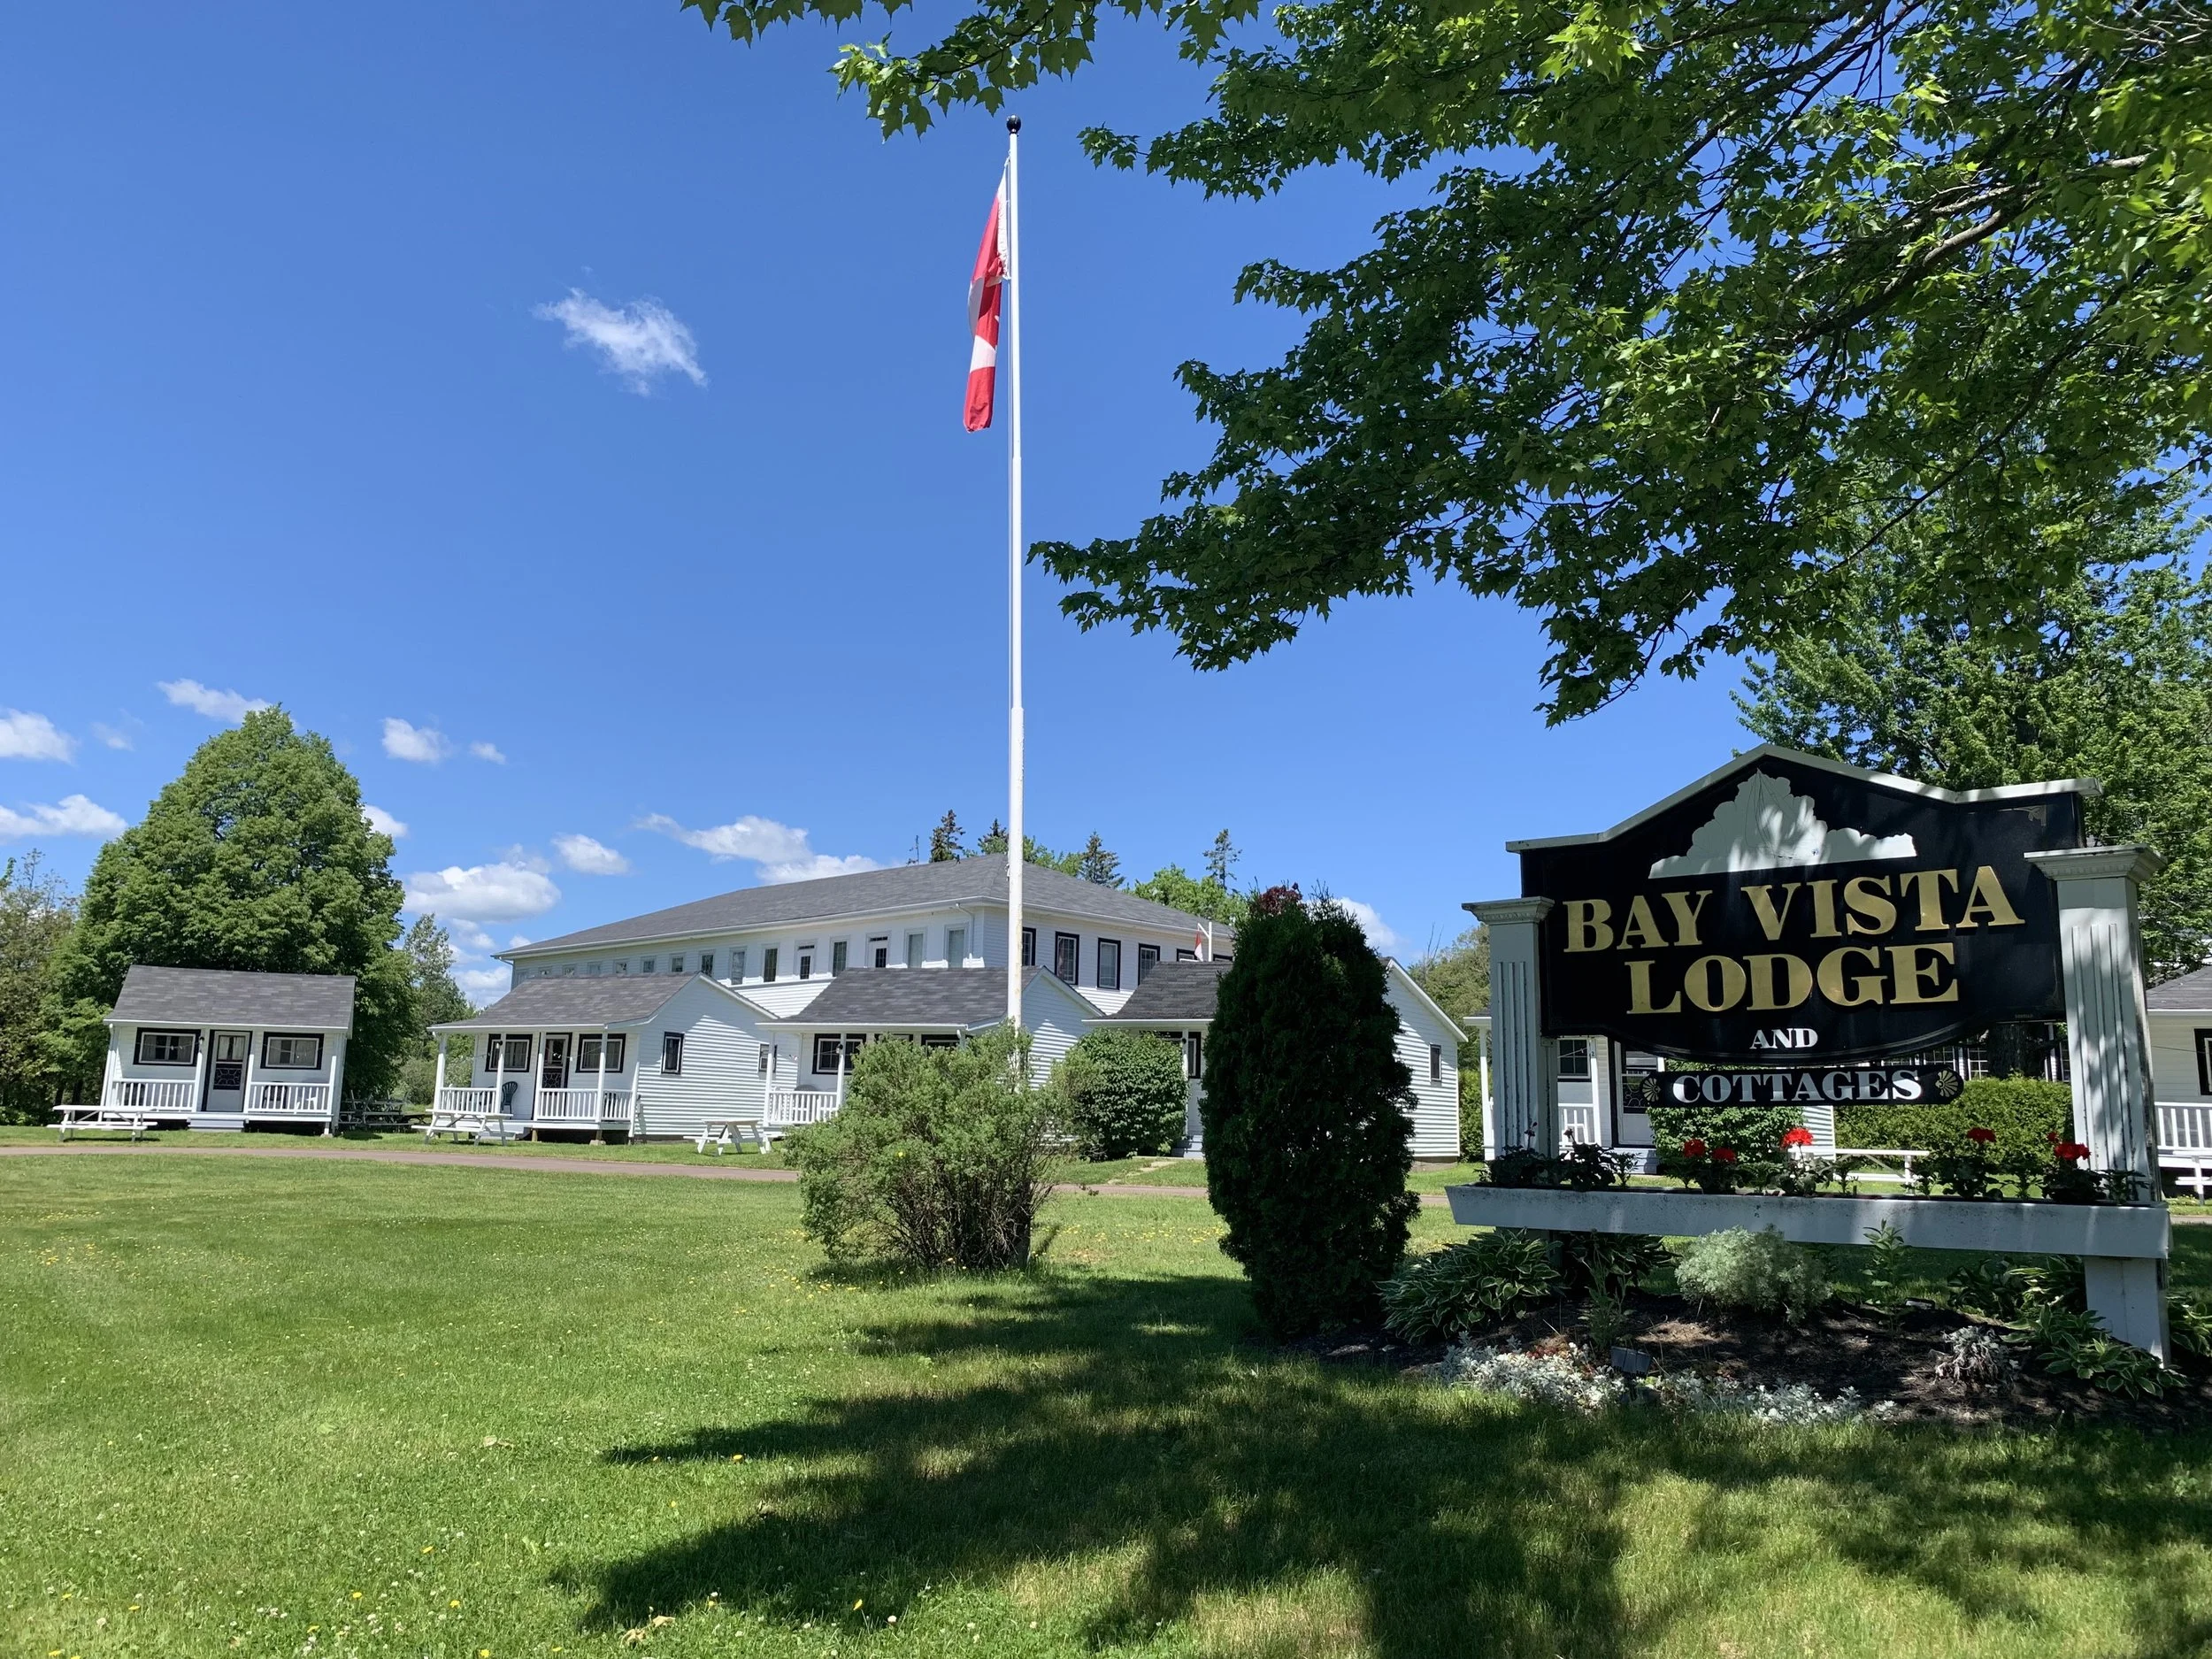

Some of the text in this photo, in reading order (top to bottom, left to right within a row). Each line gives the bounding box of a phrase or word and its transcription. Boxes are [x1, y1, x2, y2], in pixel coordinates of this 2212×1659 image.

[1562, 864, 2025, 953] BAY VISTA
[1624, 941, 1959, 1015] LODGE
[1748, 1027, 1819, 1049] AND
[1671, 1069, 1924, 1104] COTTAGES
